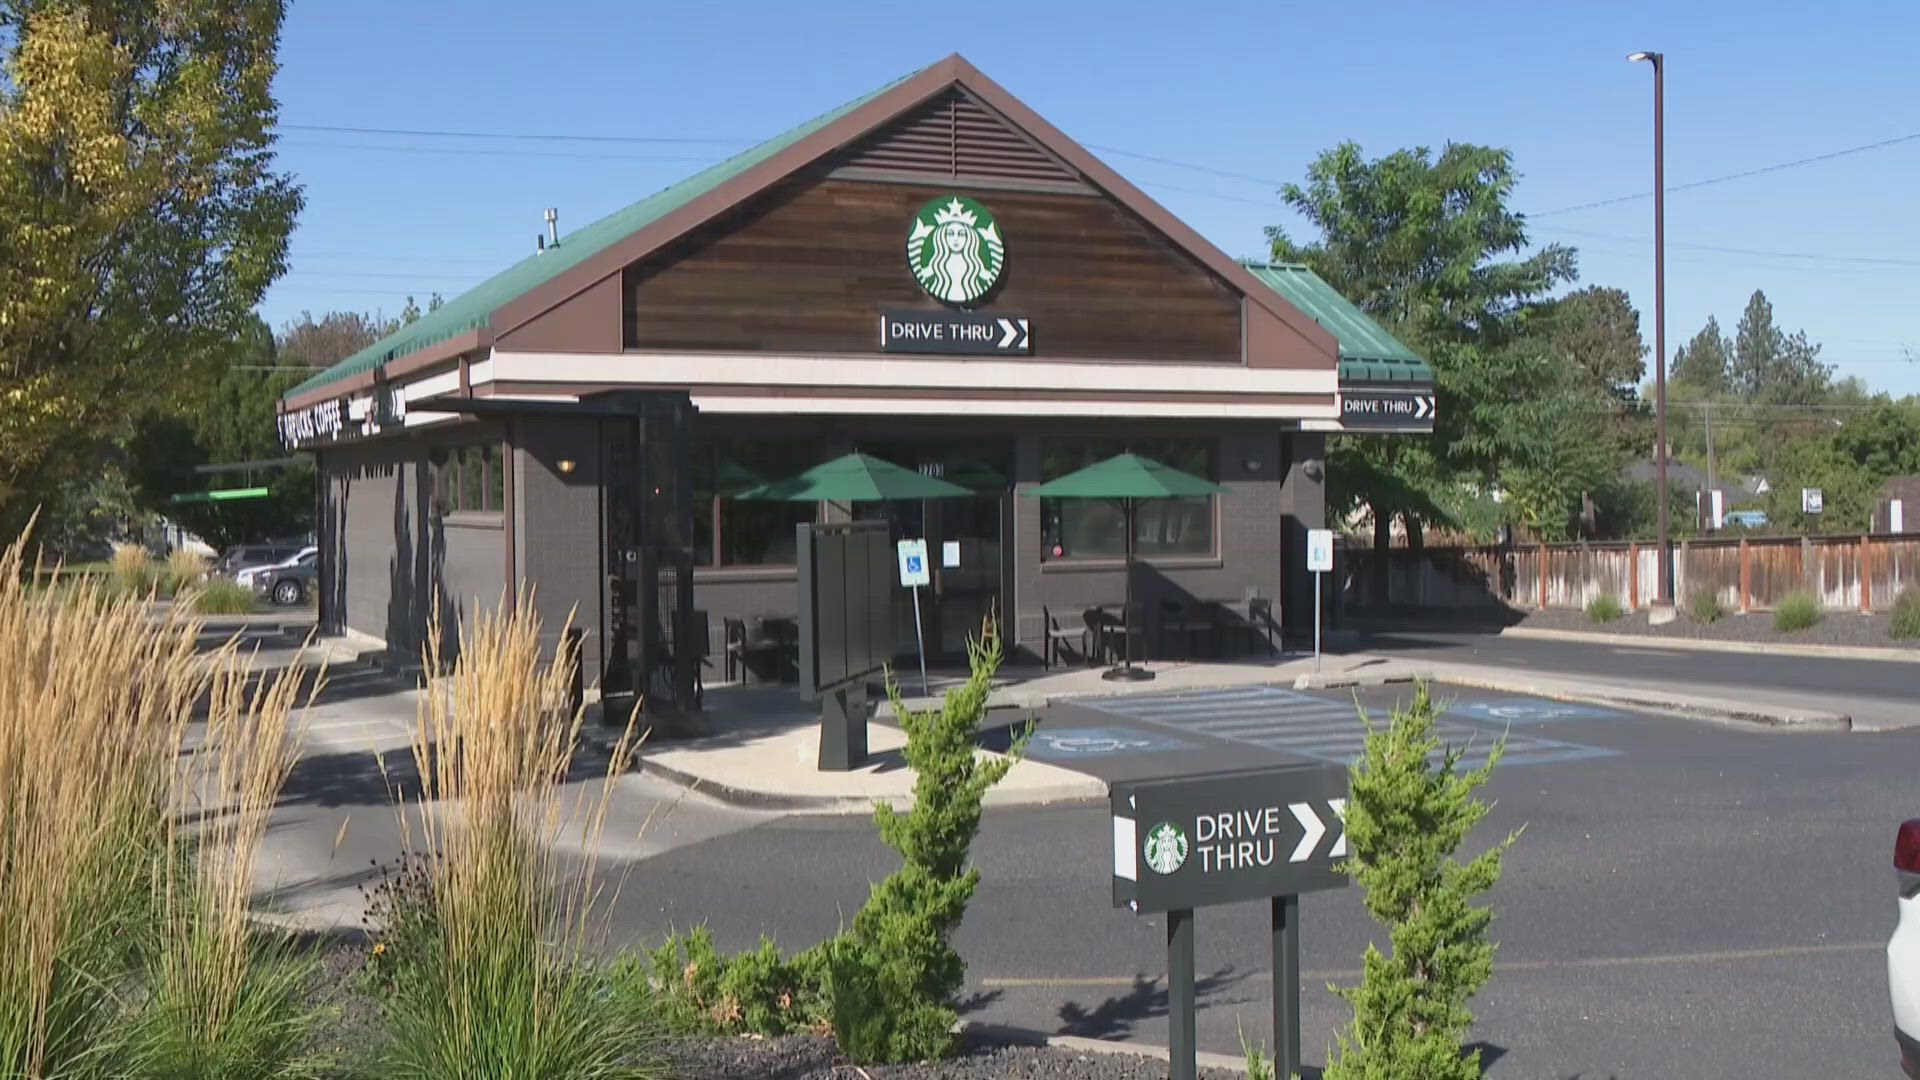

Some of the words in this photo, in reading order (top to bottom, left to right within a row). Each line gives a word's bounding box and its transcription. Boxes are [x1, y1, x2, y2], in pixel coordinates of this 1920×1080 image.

[891, 322, 943, 340] DRIVE
[949, 324, 994, 341] THRU
[1344, 399, 1379, 413] DRIVE
[1383, 400, 1413, 414] THRU
[277, 408, 314, 444] SARBUCKS
[1196, 807, 1280, 843] DRIVE
[1196, 838, 1275, 873] THRU
